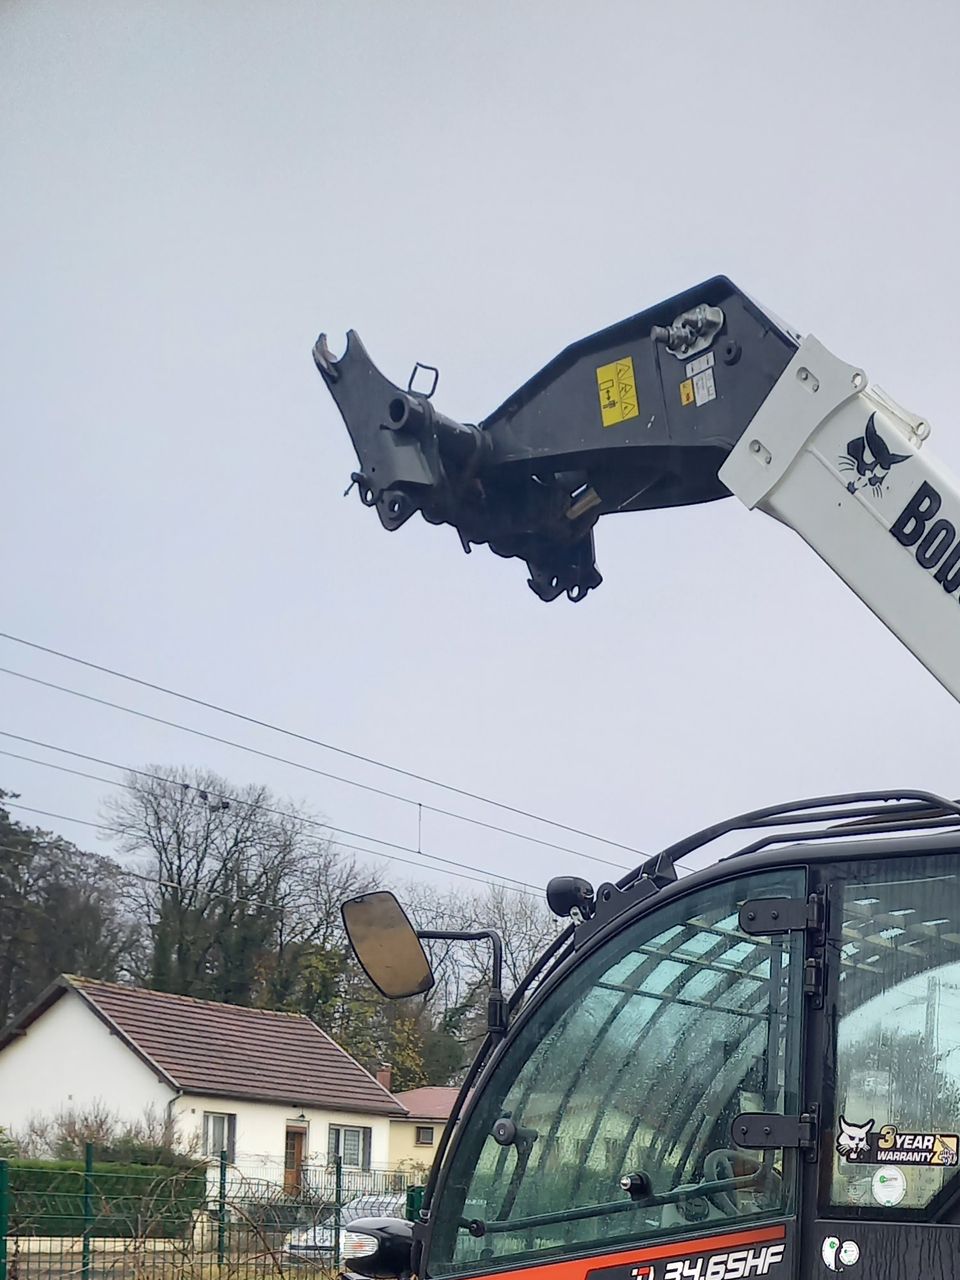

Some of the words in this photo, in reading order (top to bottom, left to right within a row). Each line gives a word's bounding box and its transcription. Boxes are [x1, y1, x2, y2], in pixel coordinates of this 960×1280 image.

[878, 1125, 896, 1149] 3
[895, 1135, 934, 1149] YEAR
[877, 1151, 934, 1162] WARRANTY
